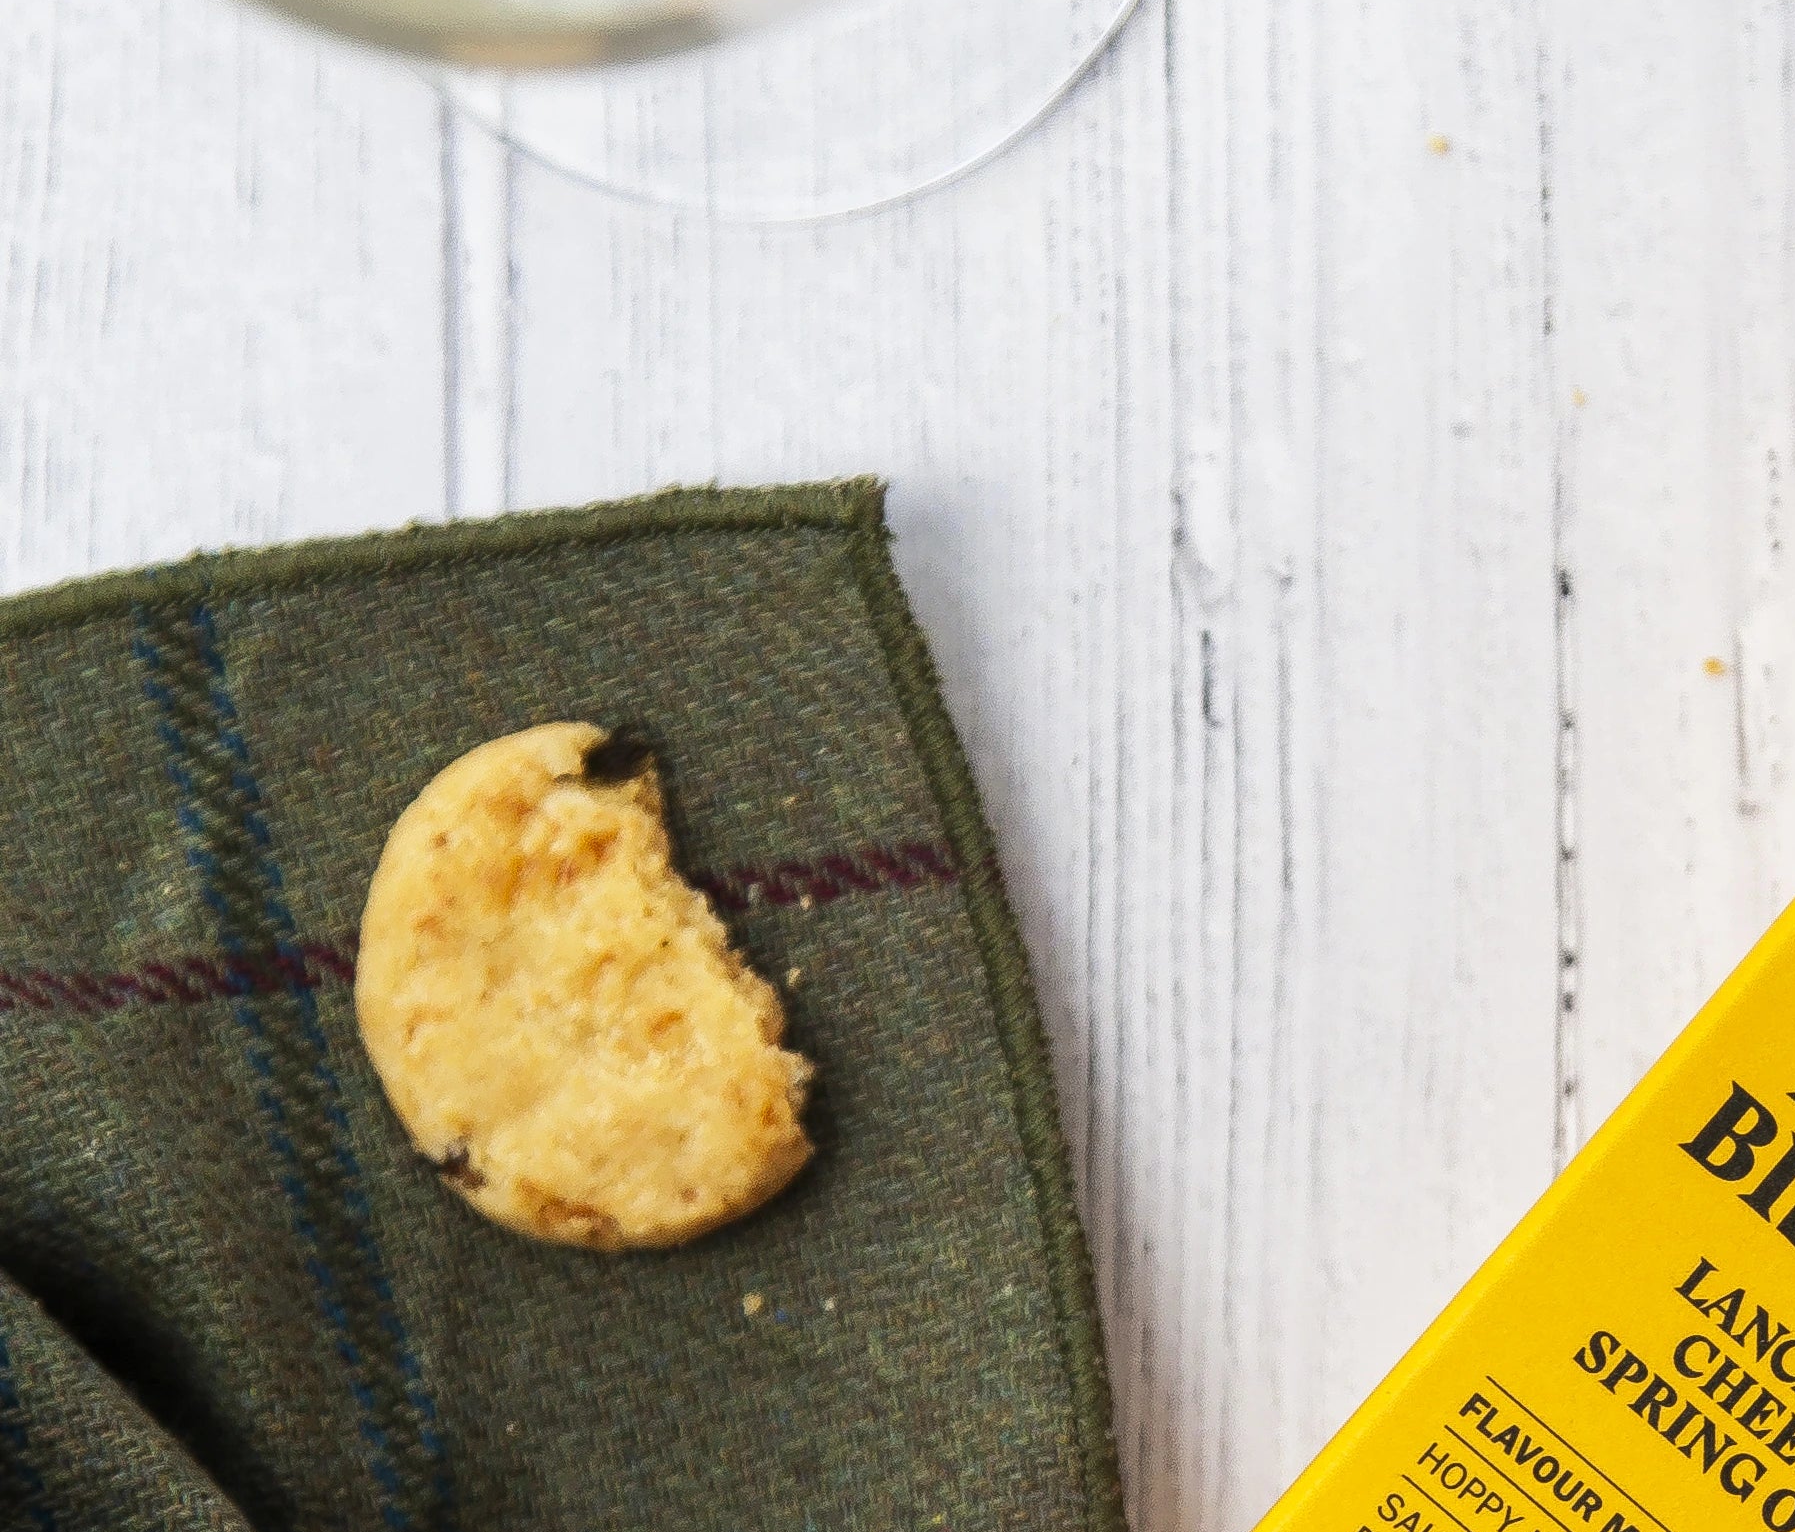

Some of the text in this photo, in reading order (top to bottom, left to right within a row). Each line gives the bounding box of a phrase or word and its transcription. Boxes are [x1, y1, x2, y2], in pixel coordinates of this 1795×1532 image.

[1459, 1393, 1602, 1522] FLAVOUR
[1573, 1331, 1767, 1503] SPRING
[1418, 1443, 1524, 1532] HOPPY
